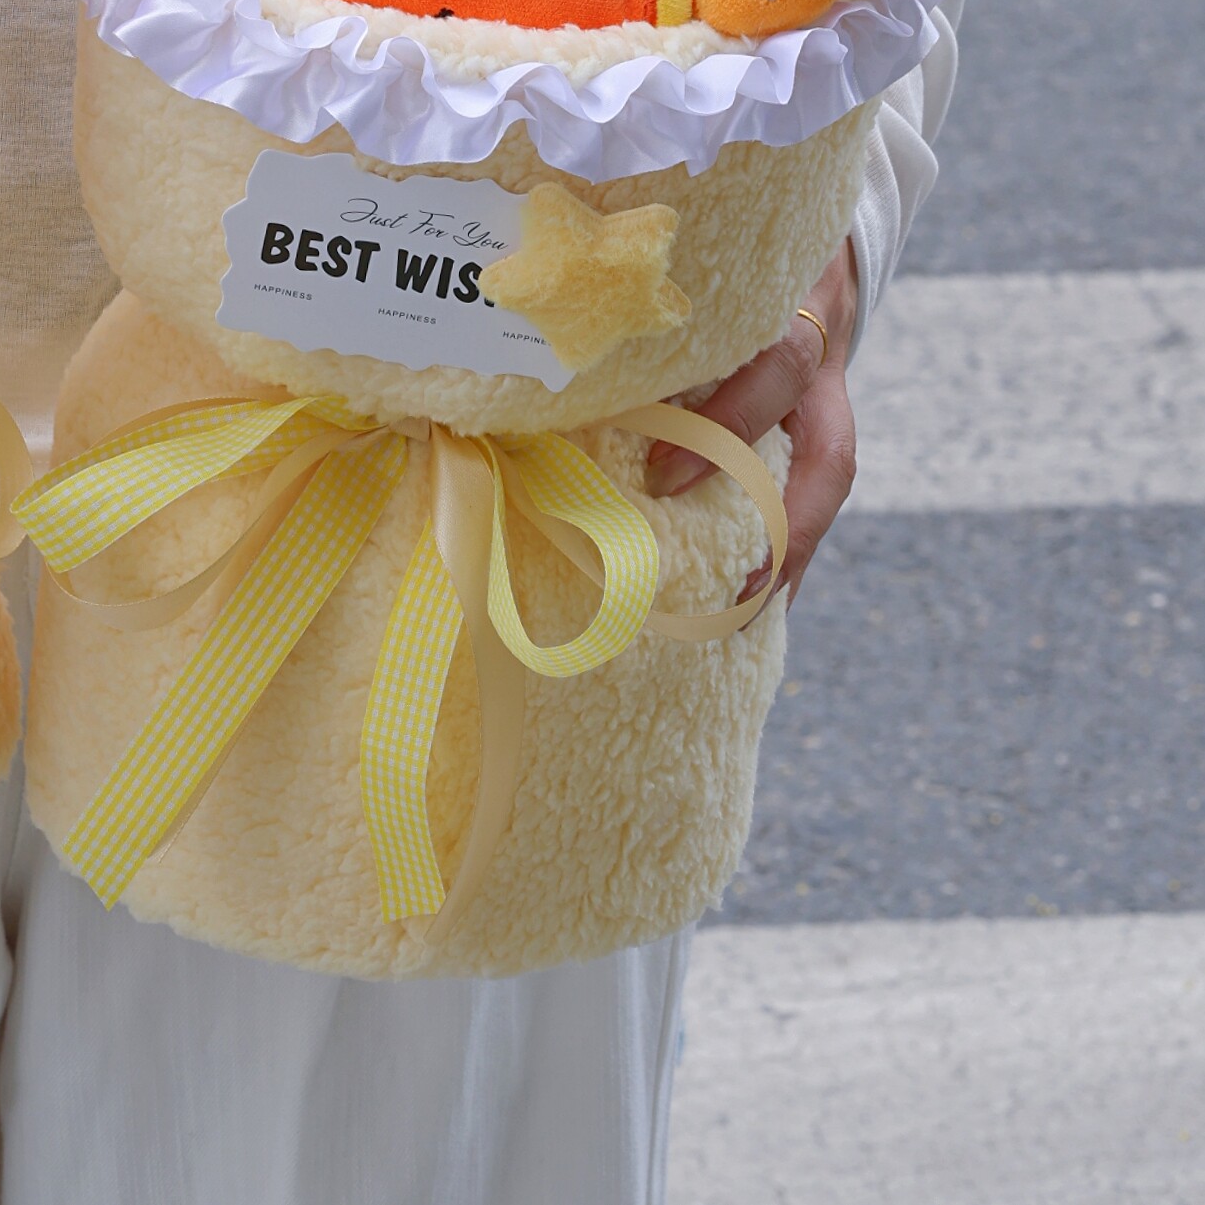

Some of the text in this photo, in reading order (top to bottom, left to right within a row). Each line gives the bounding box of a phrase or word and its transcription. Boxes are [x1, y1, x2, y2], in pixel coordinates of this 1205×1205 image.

[340, 198, 509, 250] Just For You
[260, 222, 495, 308] BEST WIS
[254, 284, 313, 301] HAPPINESS
[378, 308, 437, 325] HAPPINESS
[502, 331, 552, 346] HAPPINE
